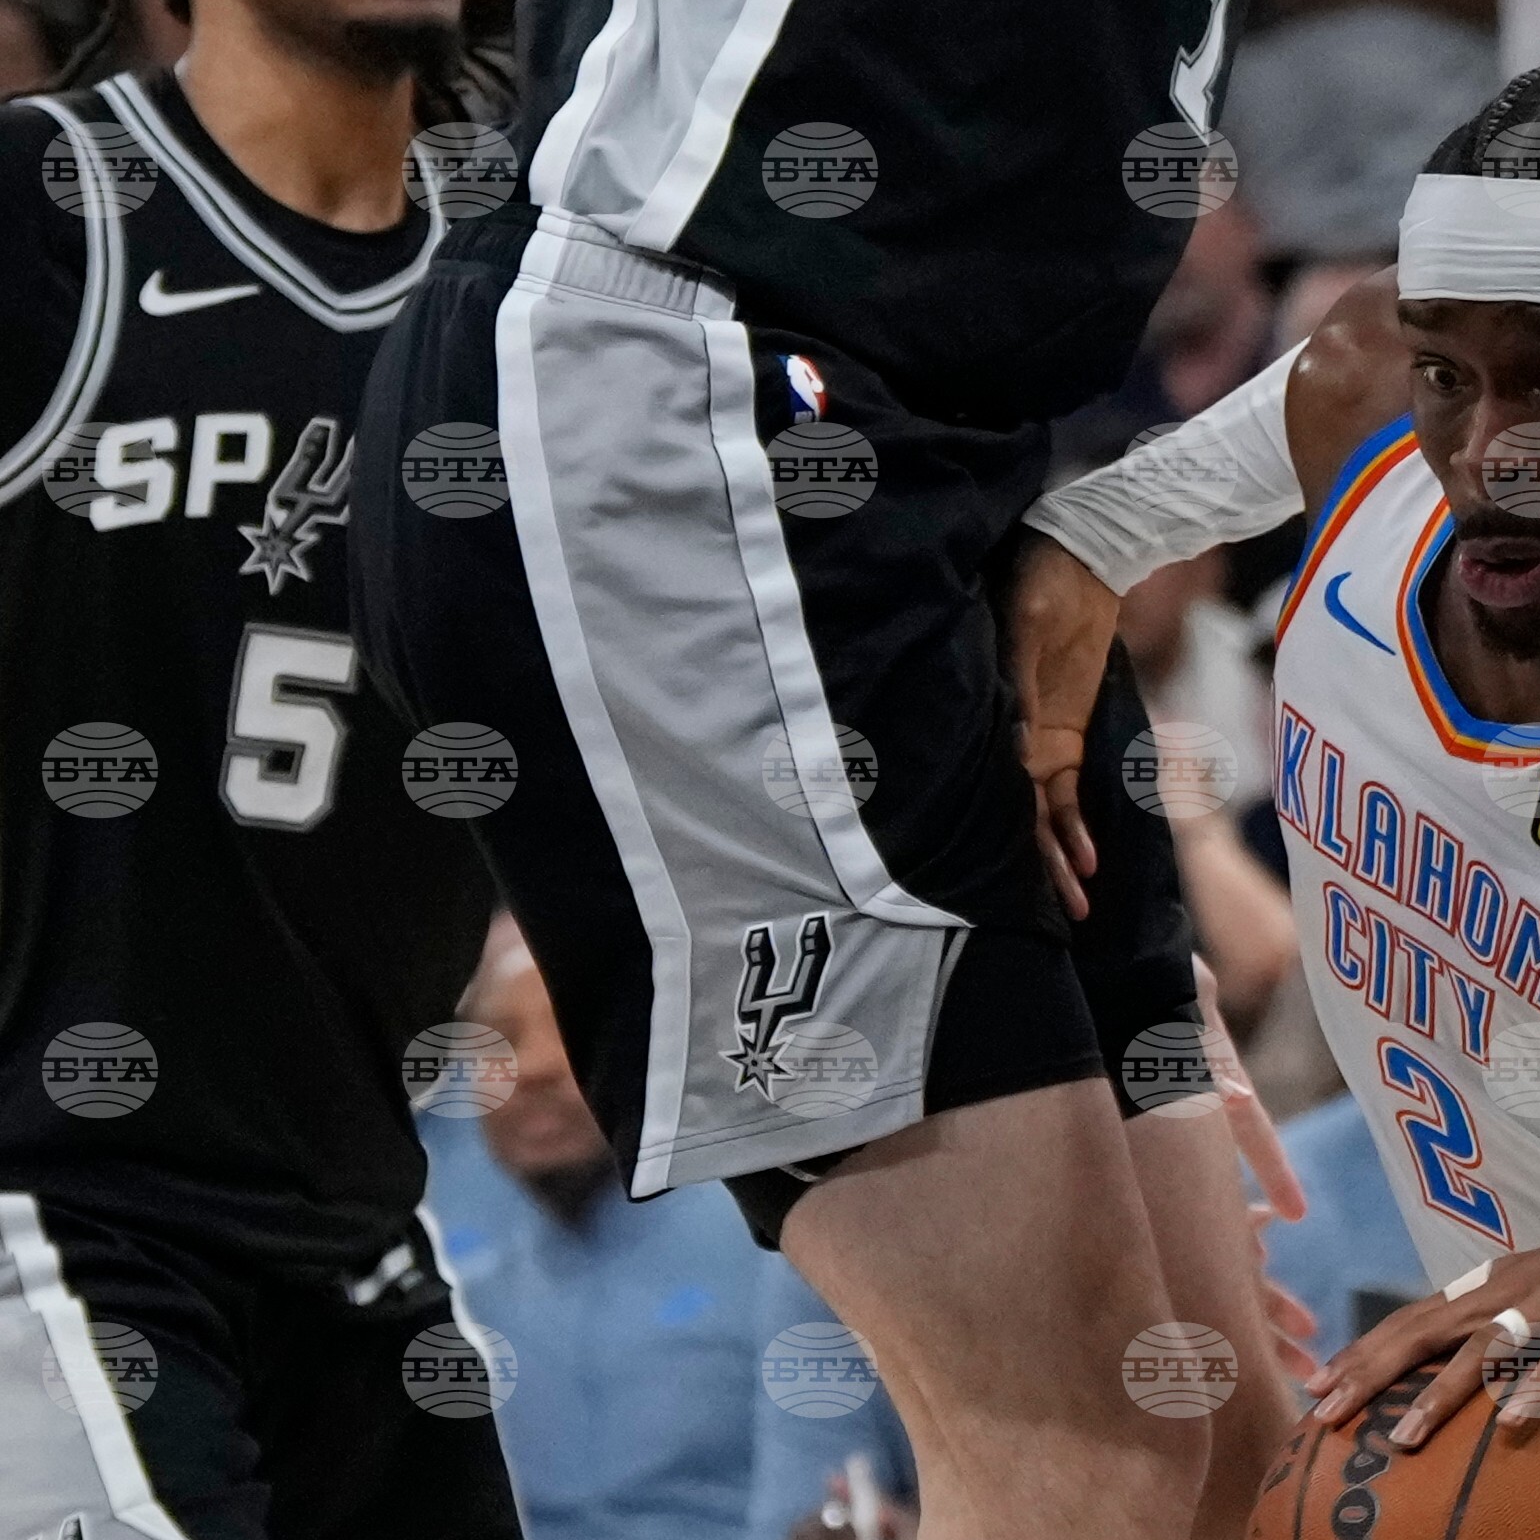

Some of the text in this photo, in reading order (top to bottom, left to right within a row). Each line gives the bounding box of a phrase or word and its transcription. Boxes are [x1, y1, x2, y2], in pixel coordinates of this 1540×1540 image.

[218, 621, 358, 834] 5
[1323, 881, 1495, 1066] CITY
[1377, 1036, 1514, 1251] 2
